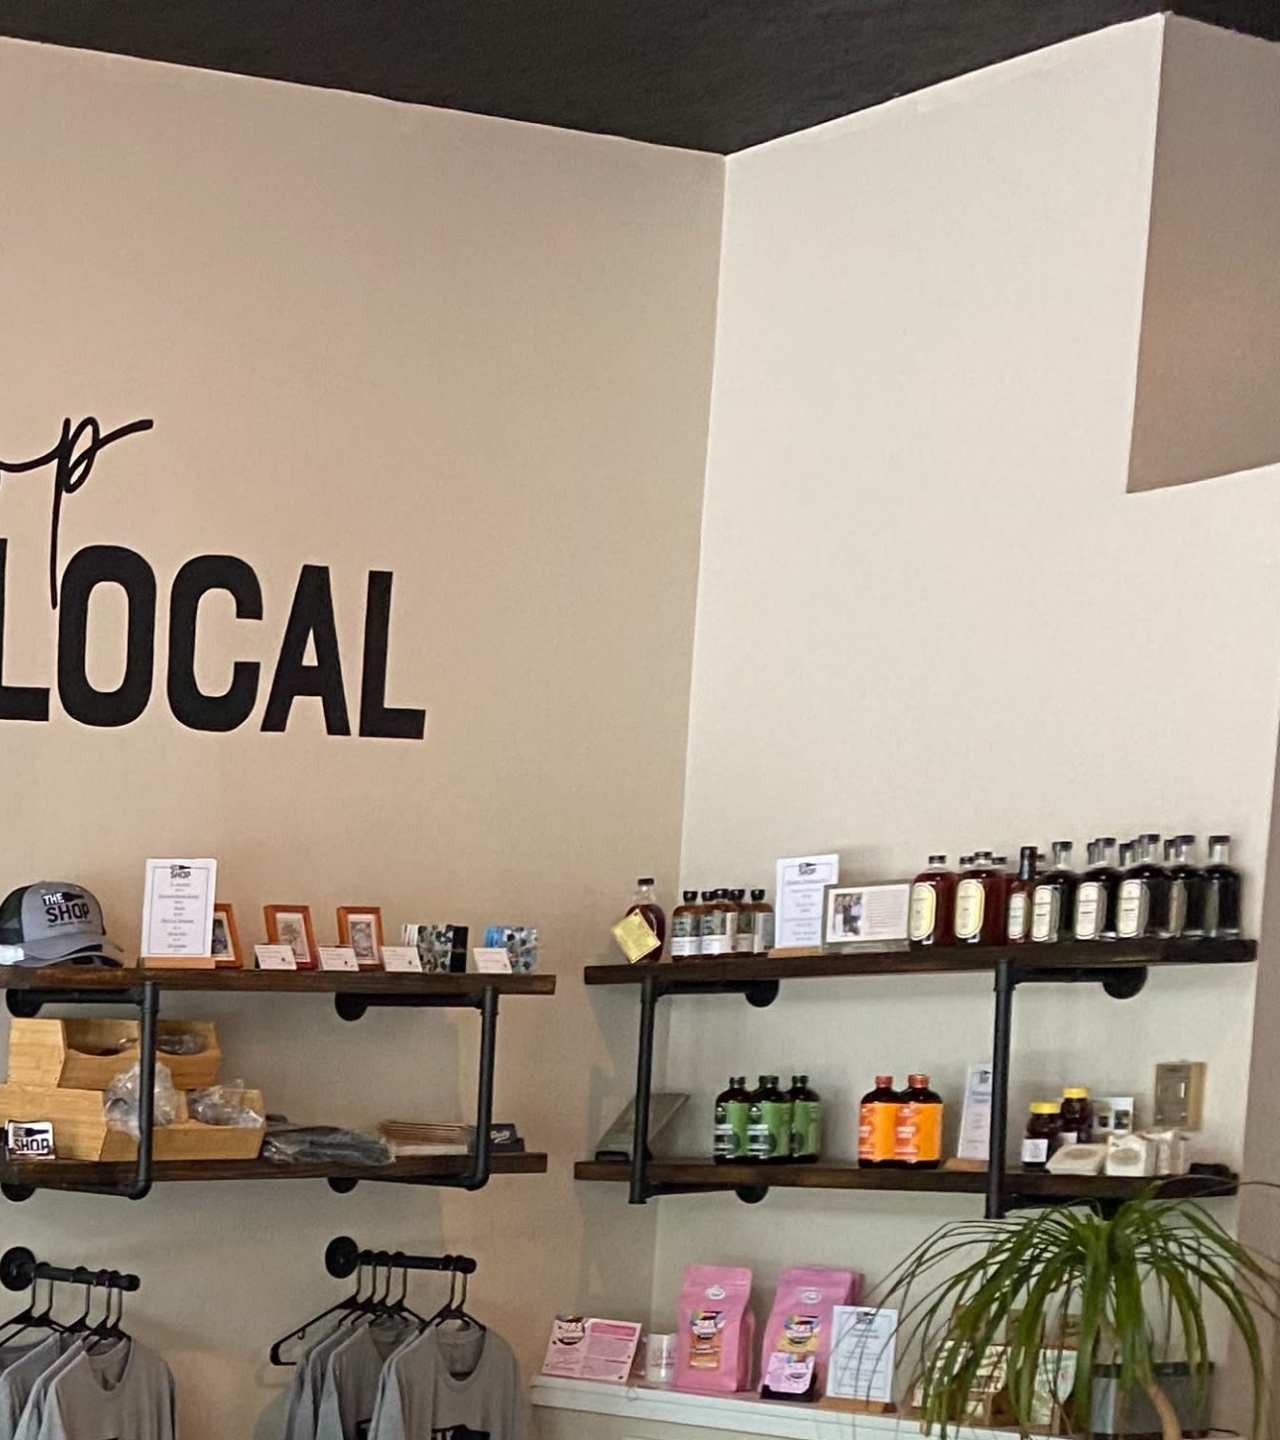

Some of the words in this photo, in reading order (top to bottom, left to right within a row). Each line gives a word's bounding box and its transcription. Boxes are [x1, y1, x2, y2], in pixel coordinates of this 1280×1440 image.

[44, 893, 64, 905] THE
[45, 903, 90, 923] SHOP
[14, 1138, 50, 1152] SHOP
